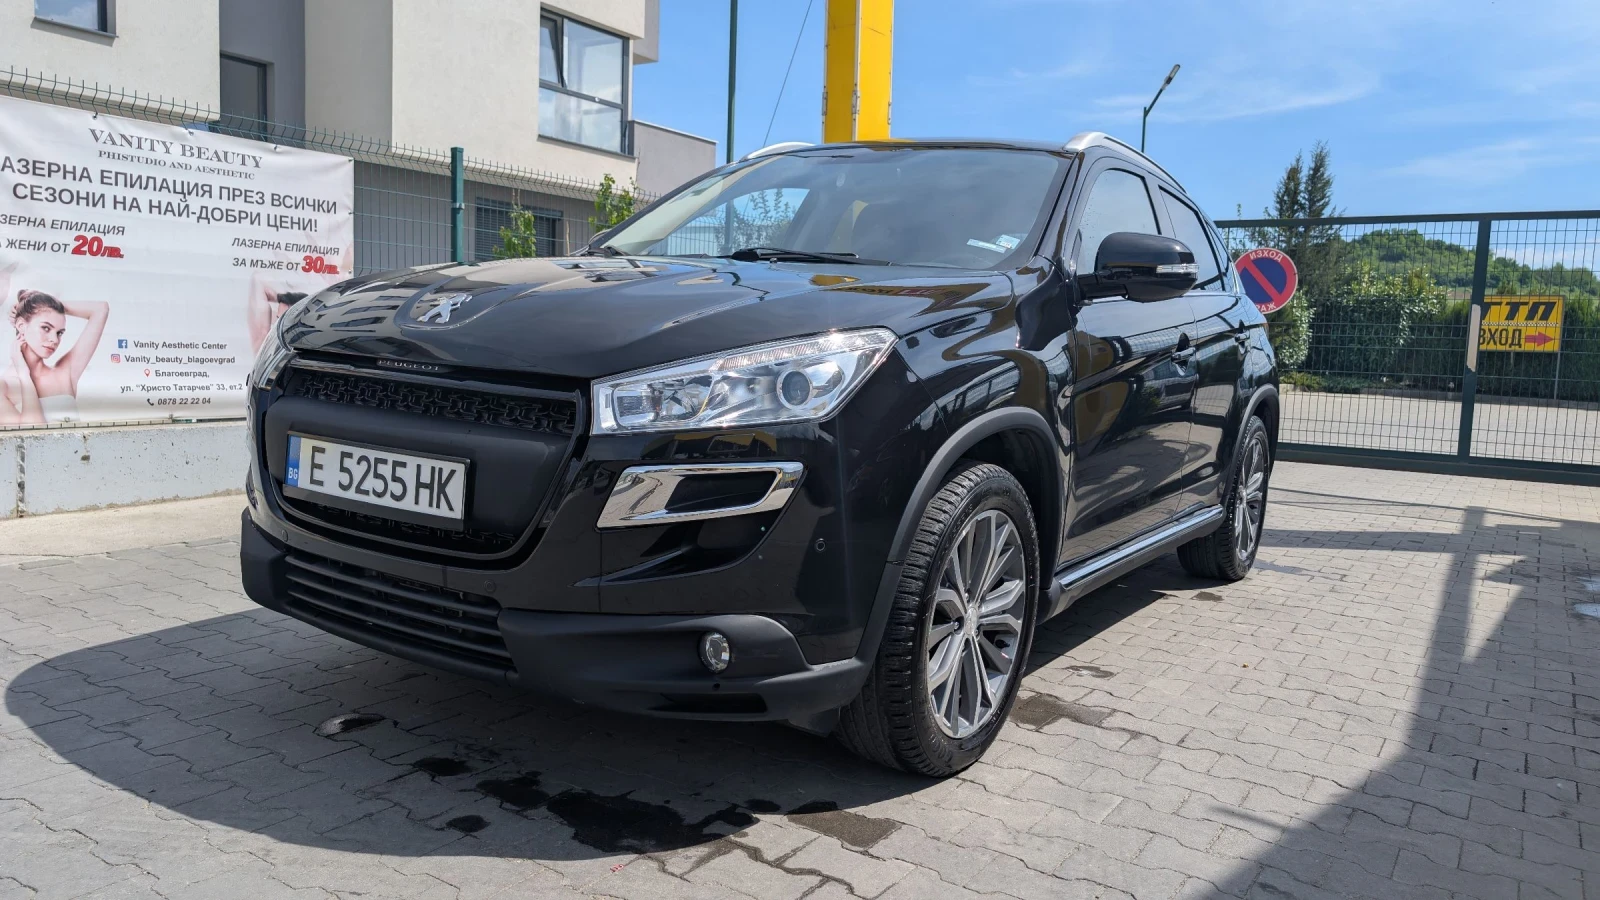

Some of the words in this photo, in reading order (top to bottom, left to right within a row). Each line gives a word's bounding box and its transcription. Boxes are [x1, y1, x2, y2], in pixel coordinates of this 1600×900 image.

[89, 128, 173, 155] VANITY
[180, 143, 263, 169] BEAUTY
[98, 150, 166, 168] PHISTUDIO
[169, 161, 192, 172] AND
[194, 165, 255, 181] AESTHETIC
[0, 156, 93, 183] АЗЕРНА
[100, 169, 213, 199] ЕПИЛАЦИЯ
[219, 186, 266, 205] ПРЕЗ
[271, 193, 337, 215] ВСИЧКИ
[13, 182, 106, 209] СЕЗОНИ
[113, 193, 142, 213] НА
[148, 195, 262, 225] НАЙ-ДОБРИ
[267, 213, 318, 233] ЦЕНИ!
[50, 219, 125, 236] ЕПИЛАЦИЯ
[5, 238, 47, 252] ЖЕНИ
[50, 242, 70, 254] ОТ
[231, 237, 282, 251] ЛАЗЕРНА
[284, 242, 340, 256] ЕПИЛАЦИЯ
[1249, 250, 1284, 262] ИЗХОД
[232, 257, 247, 267] ЗА
[249, 258, 284, 270] МЪЖЕ
[286, 262, 300, 272] ОТ
[133, 340, 160, 350] Vanity
[161, 340, 200, 350] Aesthetic
[201, 341, 227, 350] Center
[154, 369, 210, 378] Благоевград,
[120, 385, 134, 393] ул.
[157, 398, 177, 406] 0878
[288, 467, 299, 480] BG
[309, 445, 326, 487] E
[338, 450, 407, 502] 5255
[414, 463, 457, 512] HK
